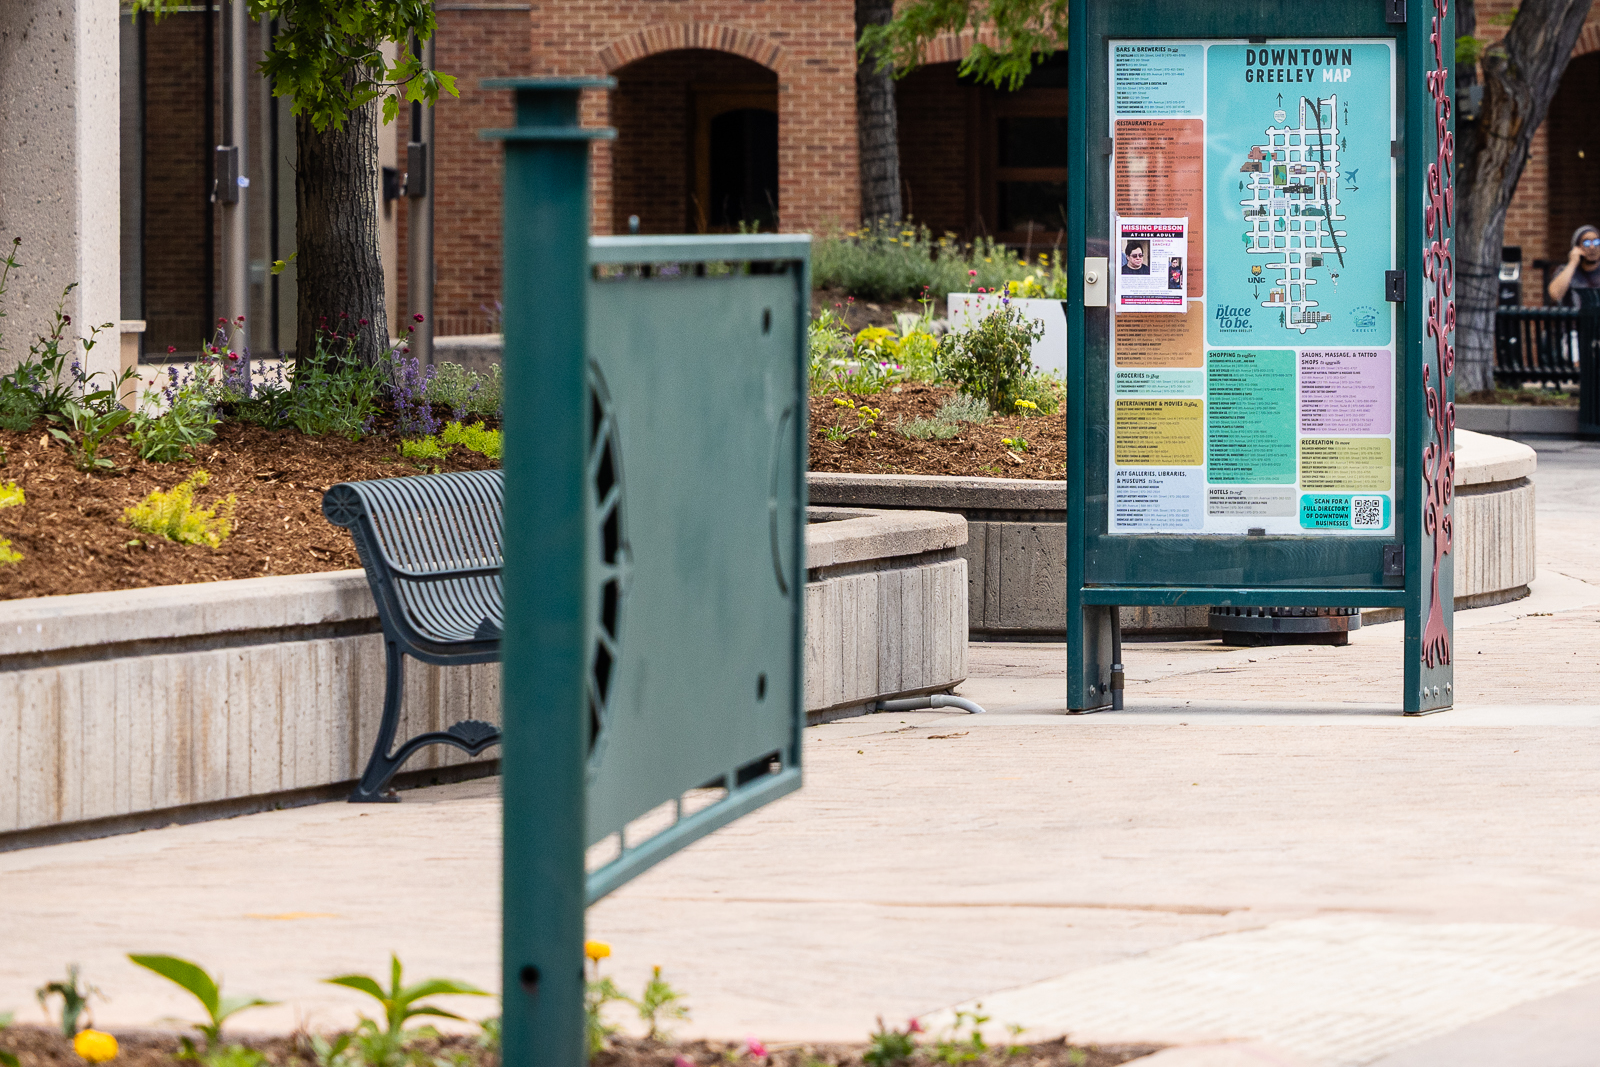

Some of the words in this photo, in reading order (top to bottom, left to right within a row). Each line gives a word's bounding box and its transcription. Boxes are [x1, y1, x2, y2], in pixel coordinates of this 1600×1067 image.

[1246, 48, 1352, 66] DOWNTOWN
[1245, 68, 1315, 83] GREELEY
[1322, 68, 1352, 83] MAP
[1216, 305, 1251, 319] place
[1219, 316, 1232, 328] to
[1234, 317, 1252, 328] be.
